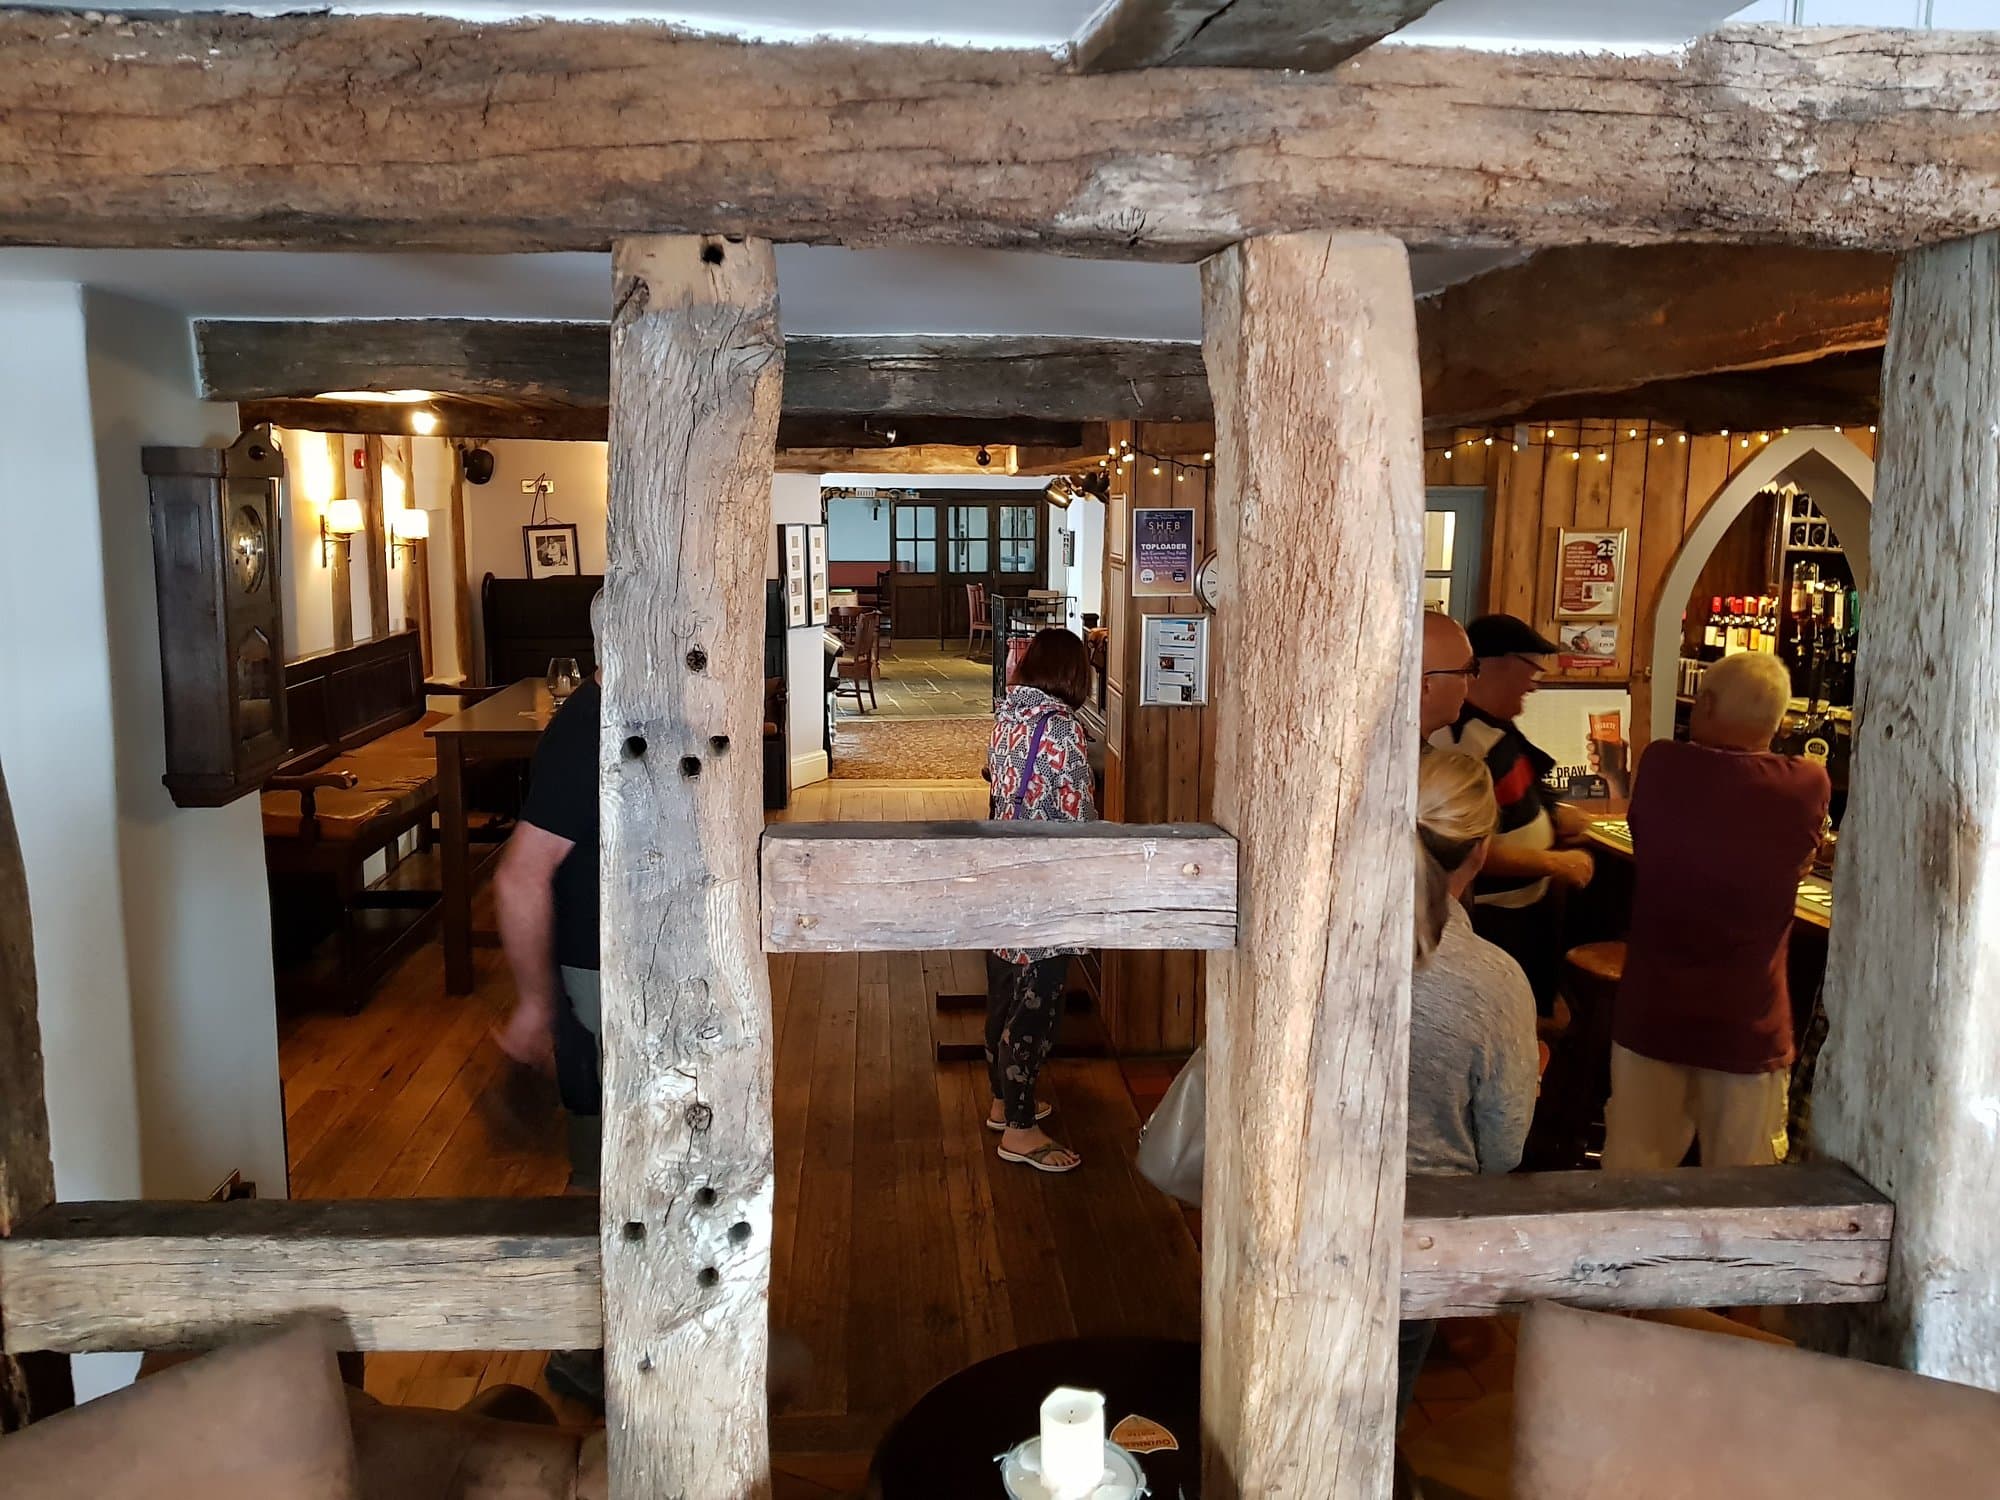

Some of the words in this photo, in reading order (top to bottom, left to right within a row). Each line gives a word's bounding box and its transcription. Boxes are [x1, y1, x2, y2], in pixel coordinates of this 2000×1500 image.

[1148, 521, 1181, 530] SHEB
[1597, 542, 1616, 556] 25
[1591, 563, 1608, 576] 18
[1556, 765, 1587, 778] DRAW
[1560, 777, 1569, 788] IT
